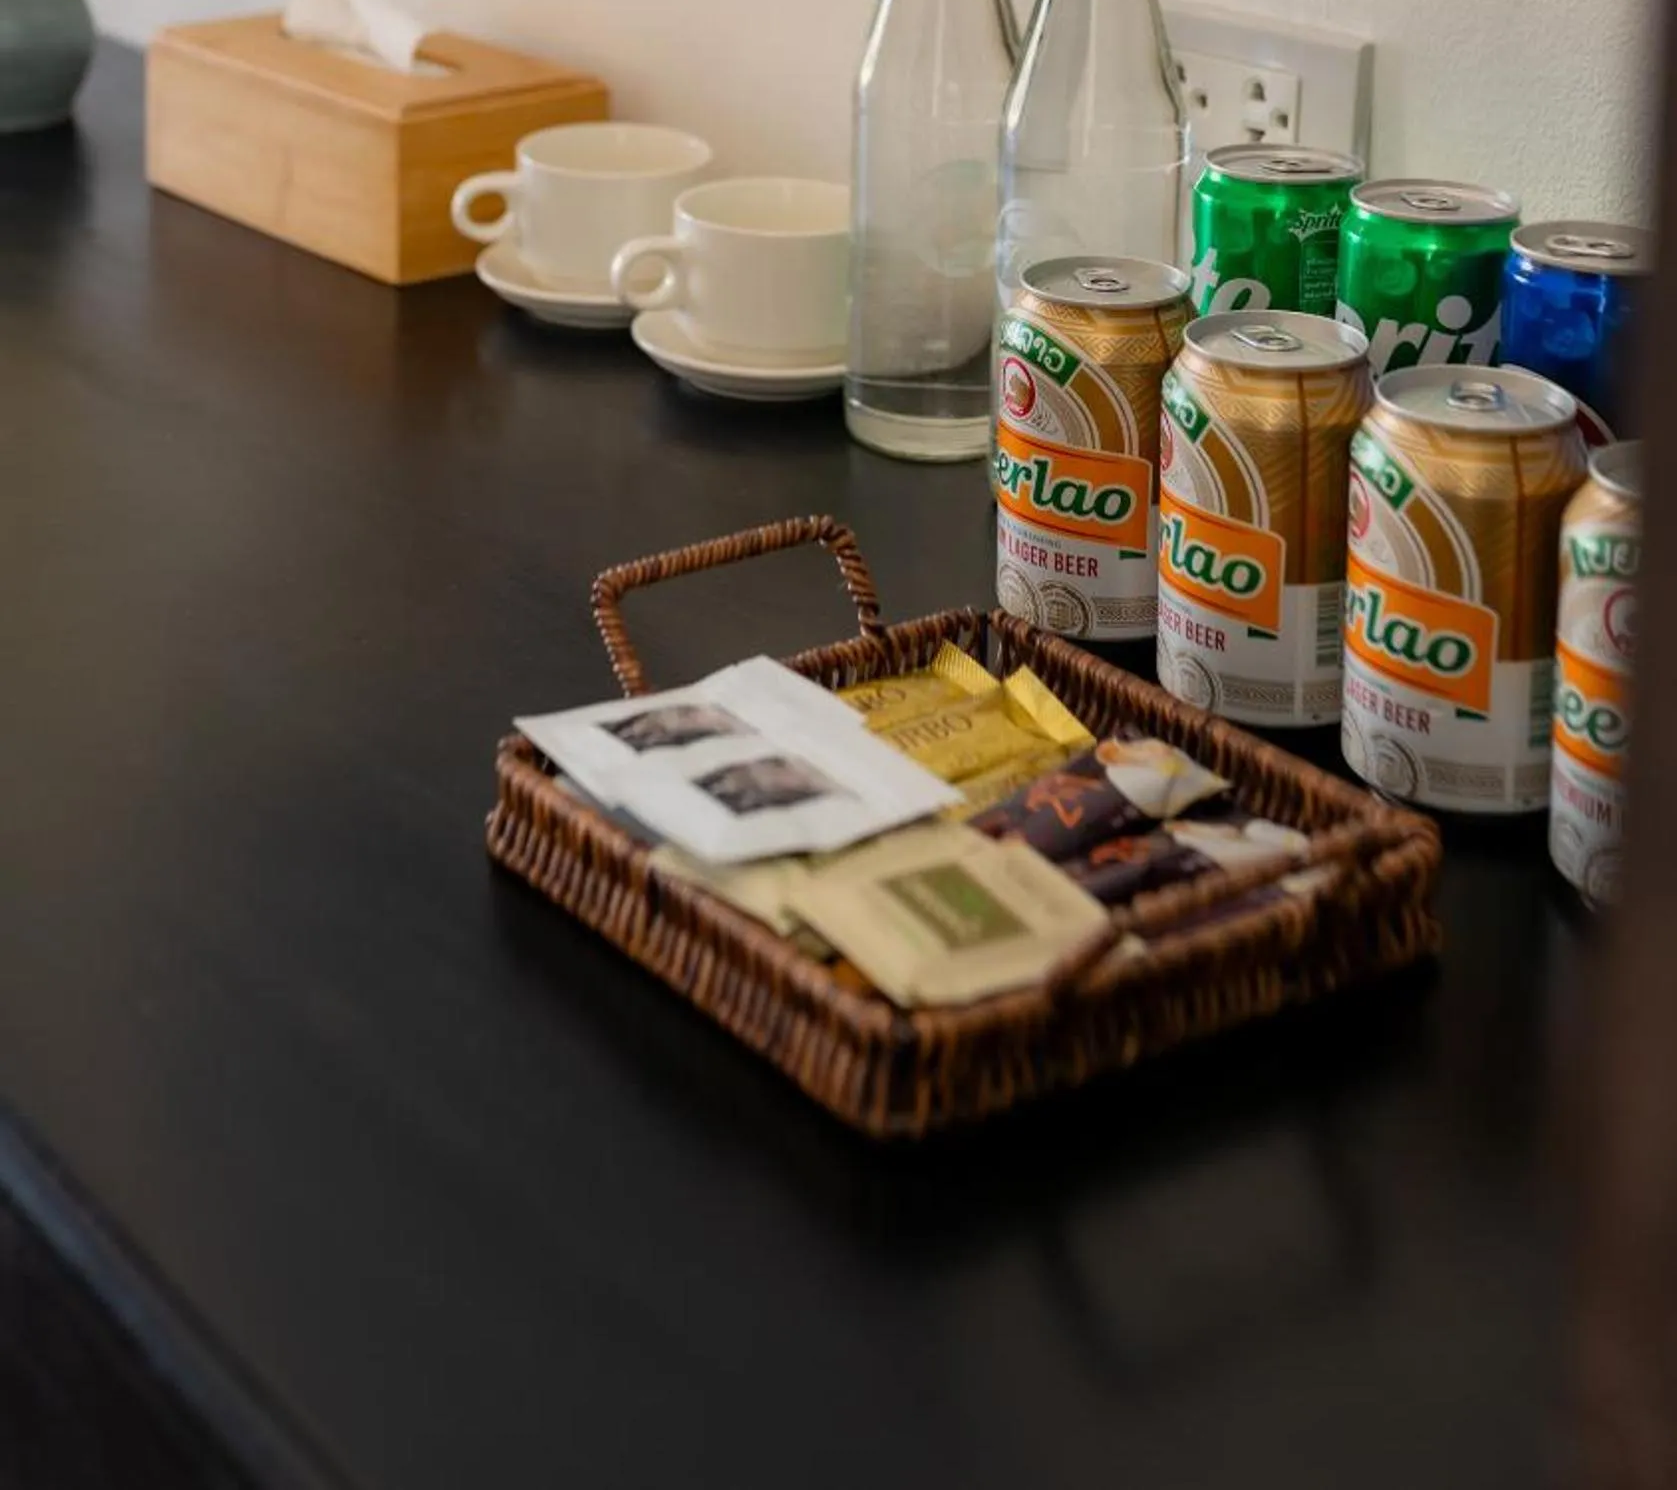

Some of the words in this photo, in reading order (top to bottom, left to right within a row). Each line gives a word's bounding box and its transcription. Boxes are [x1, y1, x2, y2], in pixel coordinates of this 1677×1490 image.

[1008, 532, 1048, 570] LAGER
[1054, 551, 1099, 578] BEER
[1186, 618, 1226, 653] BEER
[1384, 695, 1431, 736] BEER
